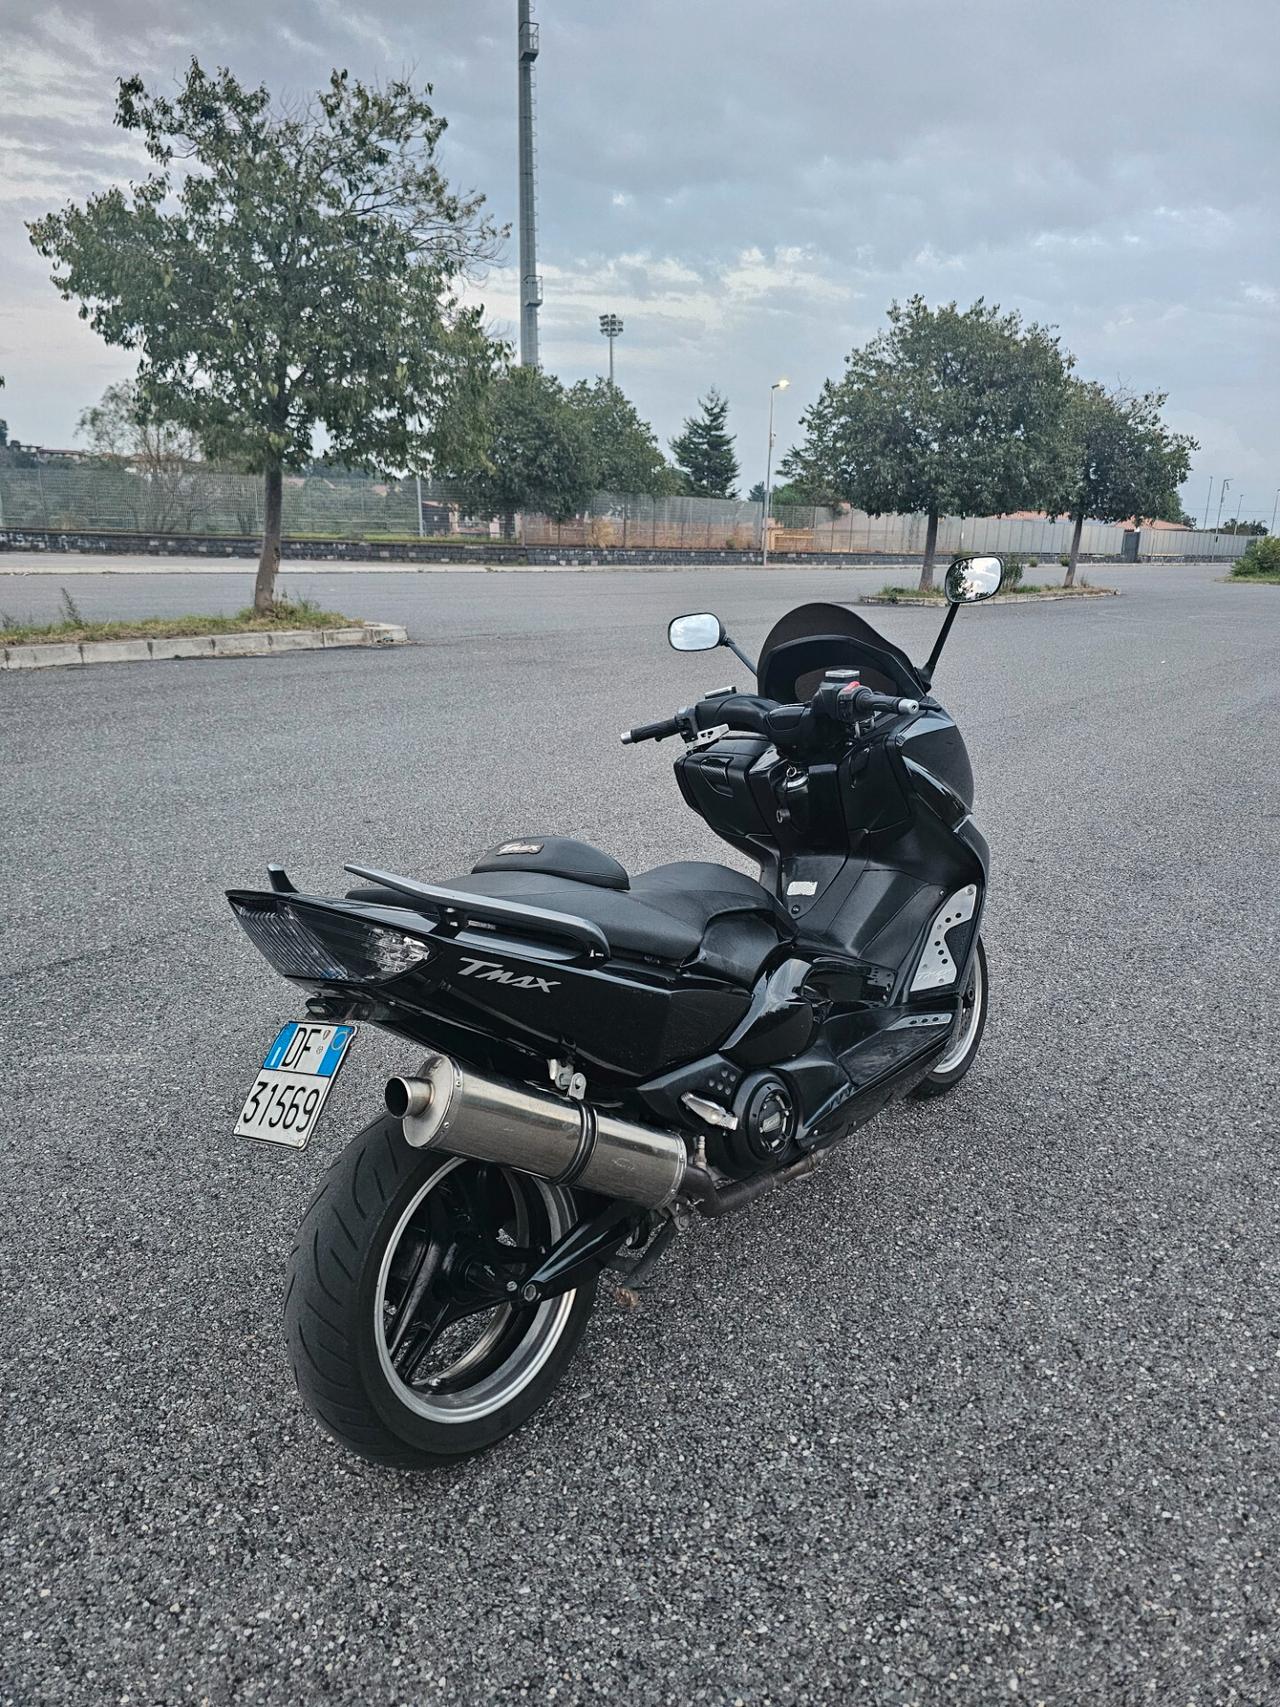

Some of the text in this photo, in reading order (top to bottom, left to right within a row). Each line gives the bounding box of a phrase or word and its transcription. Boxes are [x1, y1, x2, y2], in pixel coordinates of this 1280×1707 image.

[457, 957, 562, 993] TMAX
[281, 1027, 322, 1070] DF
[243, 1081, 321, 1133] 31569
